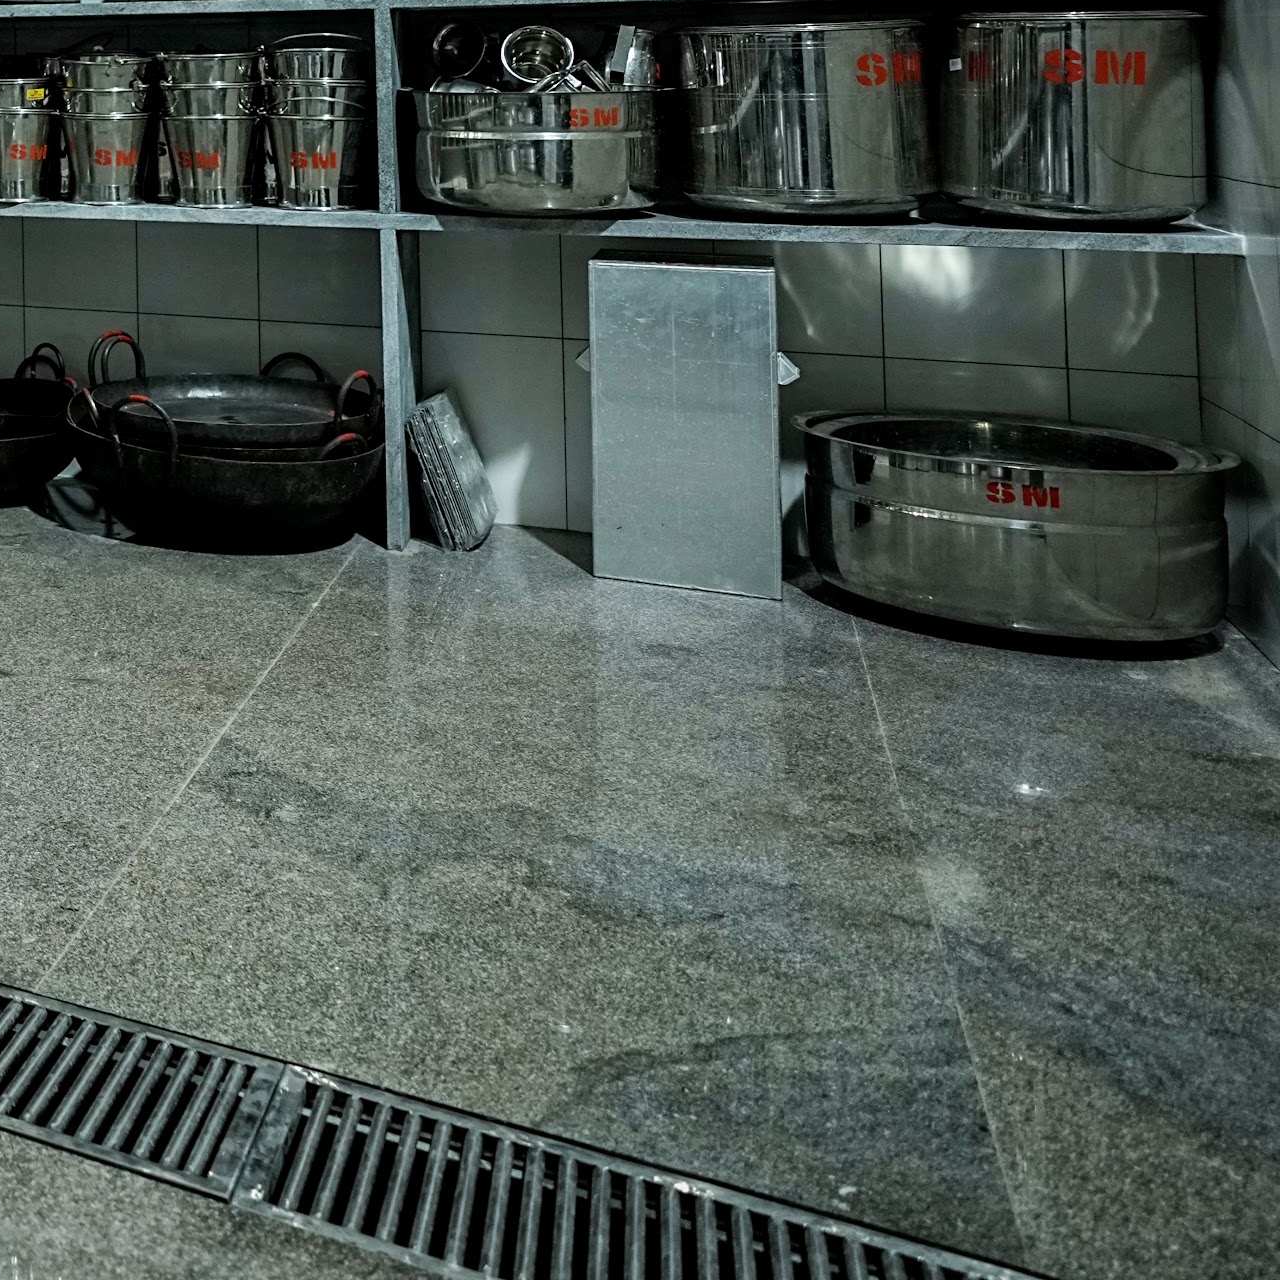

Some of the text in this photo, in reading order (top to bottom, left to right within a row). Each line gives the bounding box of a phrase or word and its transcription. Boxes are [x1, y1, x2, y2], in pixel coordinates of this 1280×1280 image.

[856, 52, 922, 87] SM
[1044, 49, 1146, 85] SM
[569, 107, 618, 128] SM
[10, 144, 47, 161] SM
[95, 149, 137, 167] SM
[178, 151, 219, 169] SM
[291, 152, 337, 169] SM
[985, 481, 1060, 510] SM
